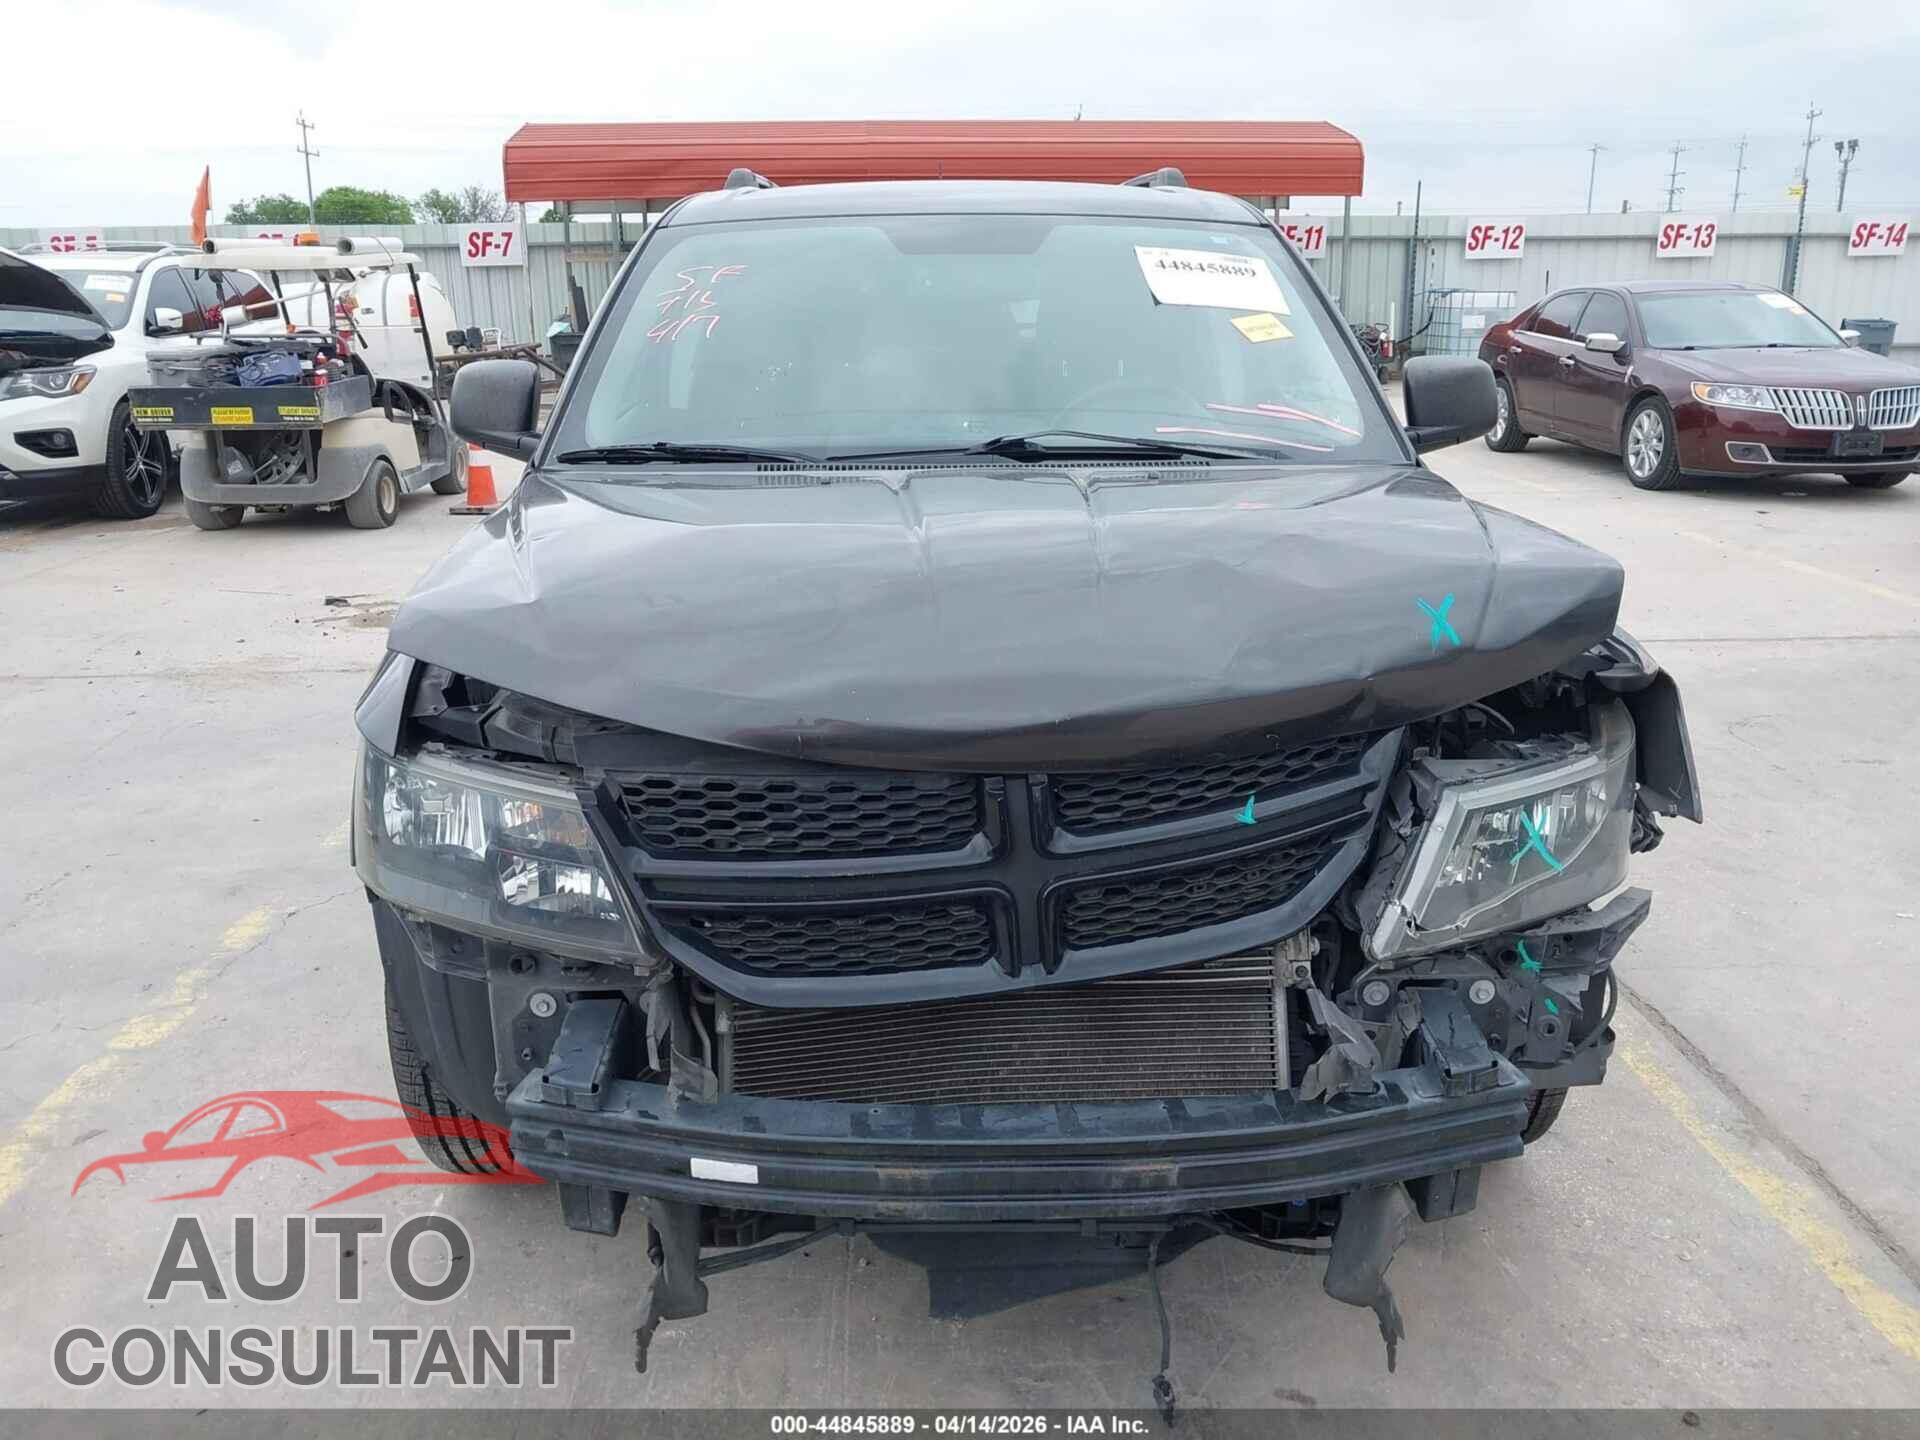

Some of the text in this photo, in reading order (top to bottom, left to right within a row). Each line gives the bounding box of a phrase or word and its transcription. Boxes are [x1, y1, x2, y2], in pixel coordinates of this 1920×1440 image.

[468, 231, 513, 258] SF-7
[1467, 225, 1524, 251] SF-12
[1659, 223, 1715, 250] SF-13
[1851, 223, 1908, 248] SF-14
[1154, 259, 1257, 278] 44845889
